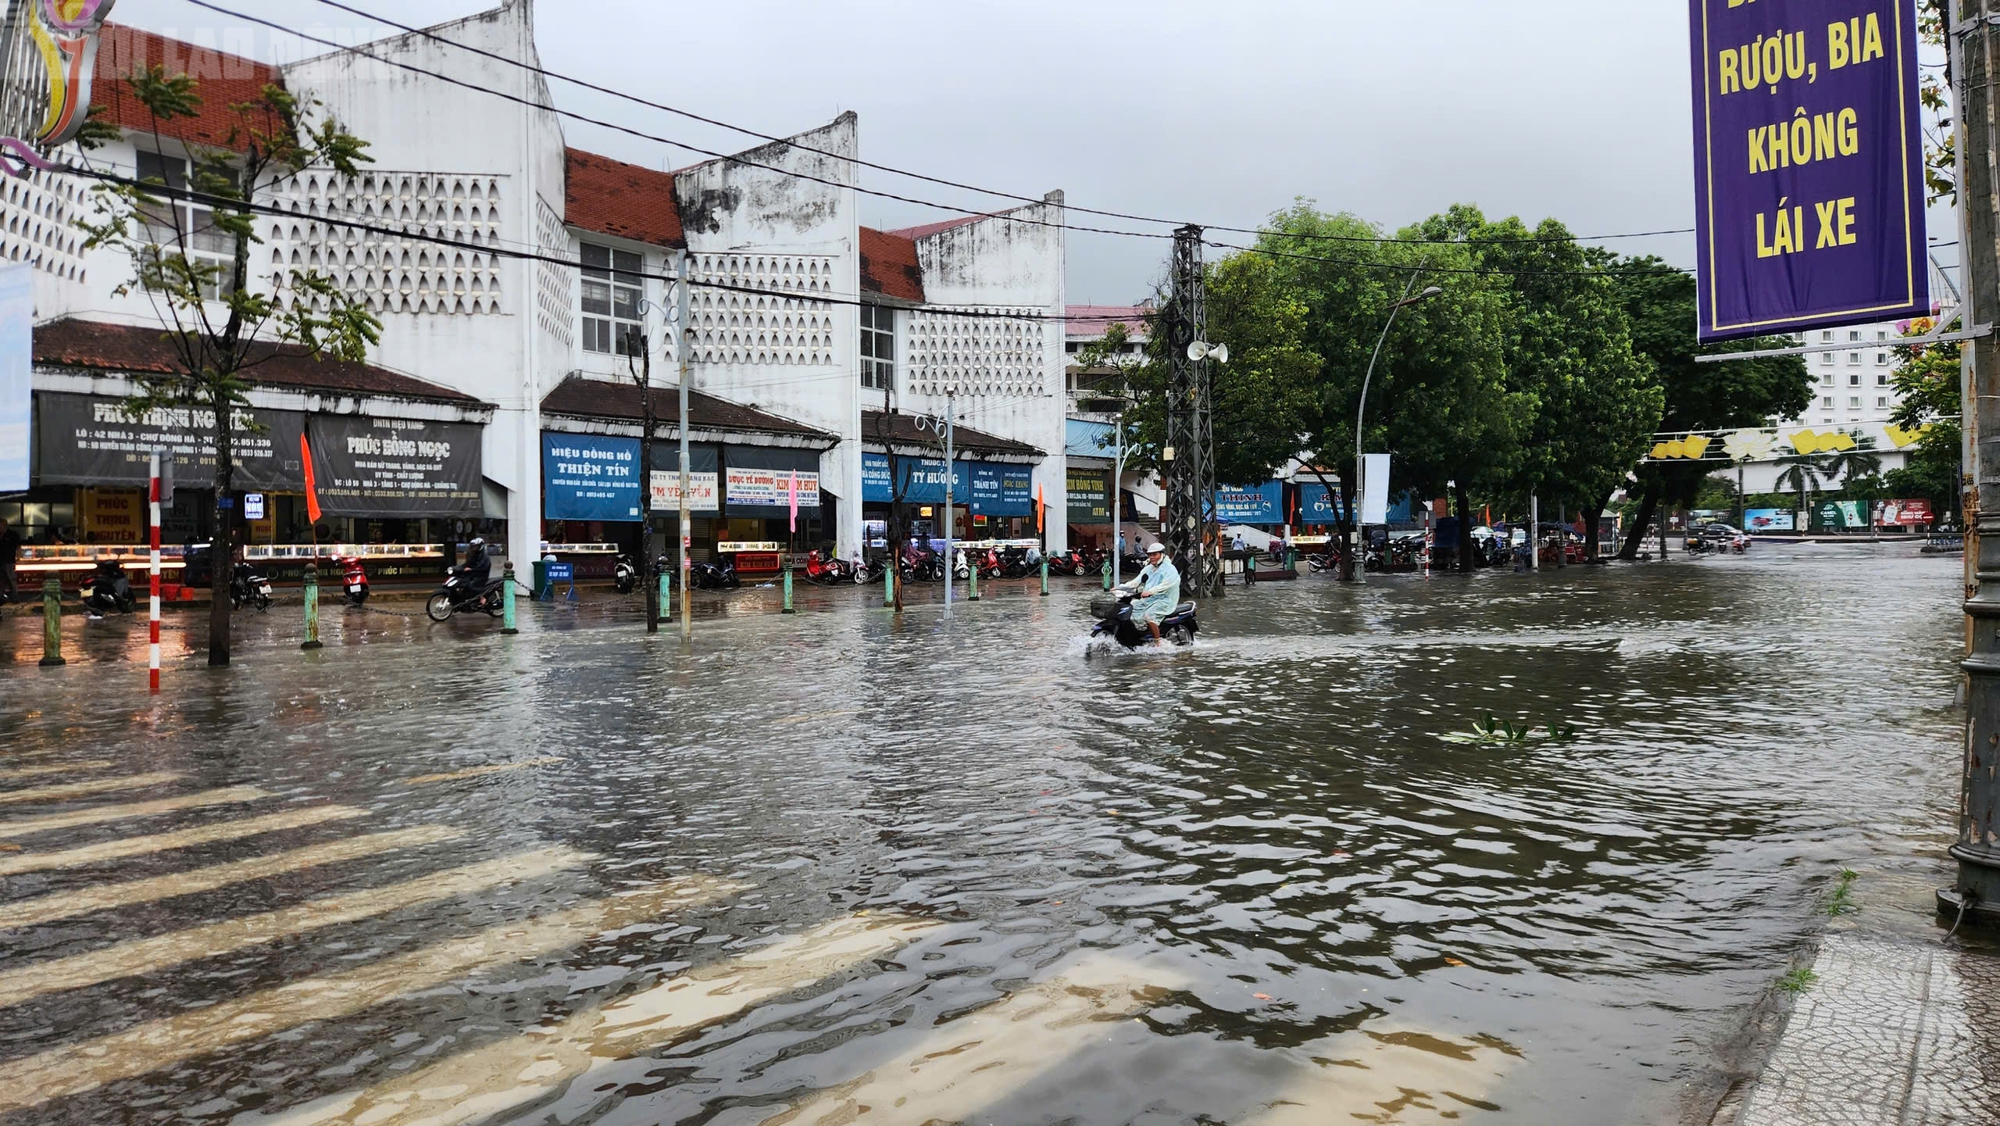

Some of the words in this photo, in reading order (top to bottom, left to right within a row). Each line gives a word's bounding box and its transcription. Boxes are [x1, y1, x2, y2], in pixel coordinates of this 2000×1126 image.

[1719, 30, 1817, 95] RƯỢU,
[1828, 12, 1884, 71] BIA
[1748, 106, 1858, 174] KHÔNG
[1756, 197, 1803, 259] LÁI
[1815, 197, 1857, 249] XE
[94, 430, 107, 439] 42
[128, 432, 134, 440] 3
[347, 433, 381, 455] PHÚC
[382, 430, 416, 457] HỒNG
[418, 441, 451, 461] NGỌC
[551, 447, 580, 459] HIỆU
[582, 446, 615, 460] ĐỒNG
[616, 448, 632, 461] HỒ
[557, 461, 602, 477] THIỆN
[605, 462, 630, 476] TÍN
[804, 480, 817, 491] HUY
